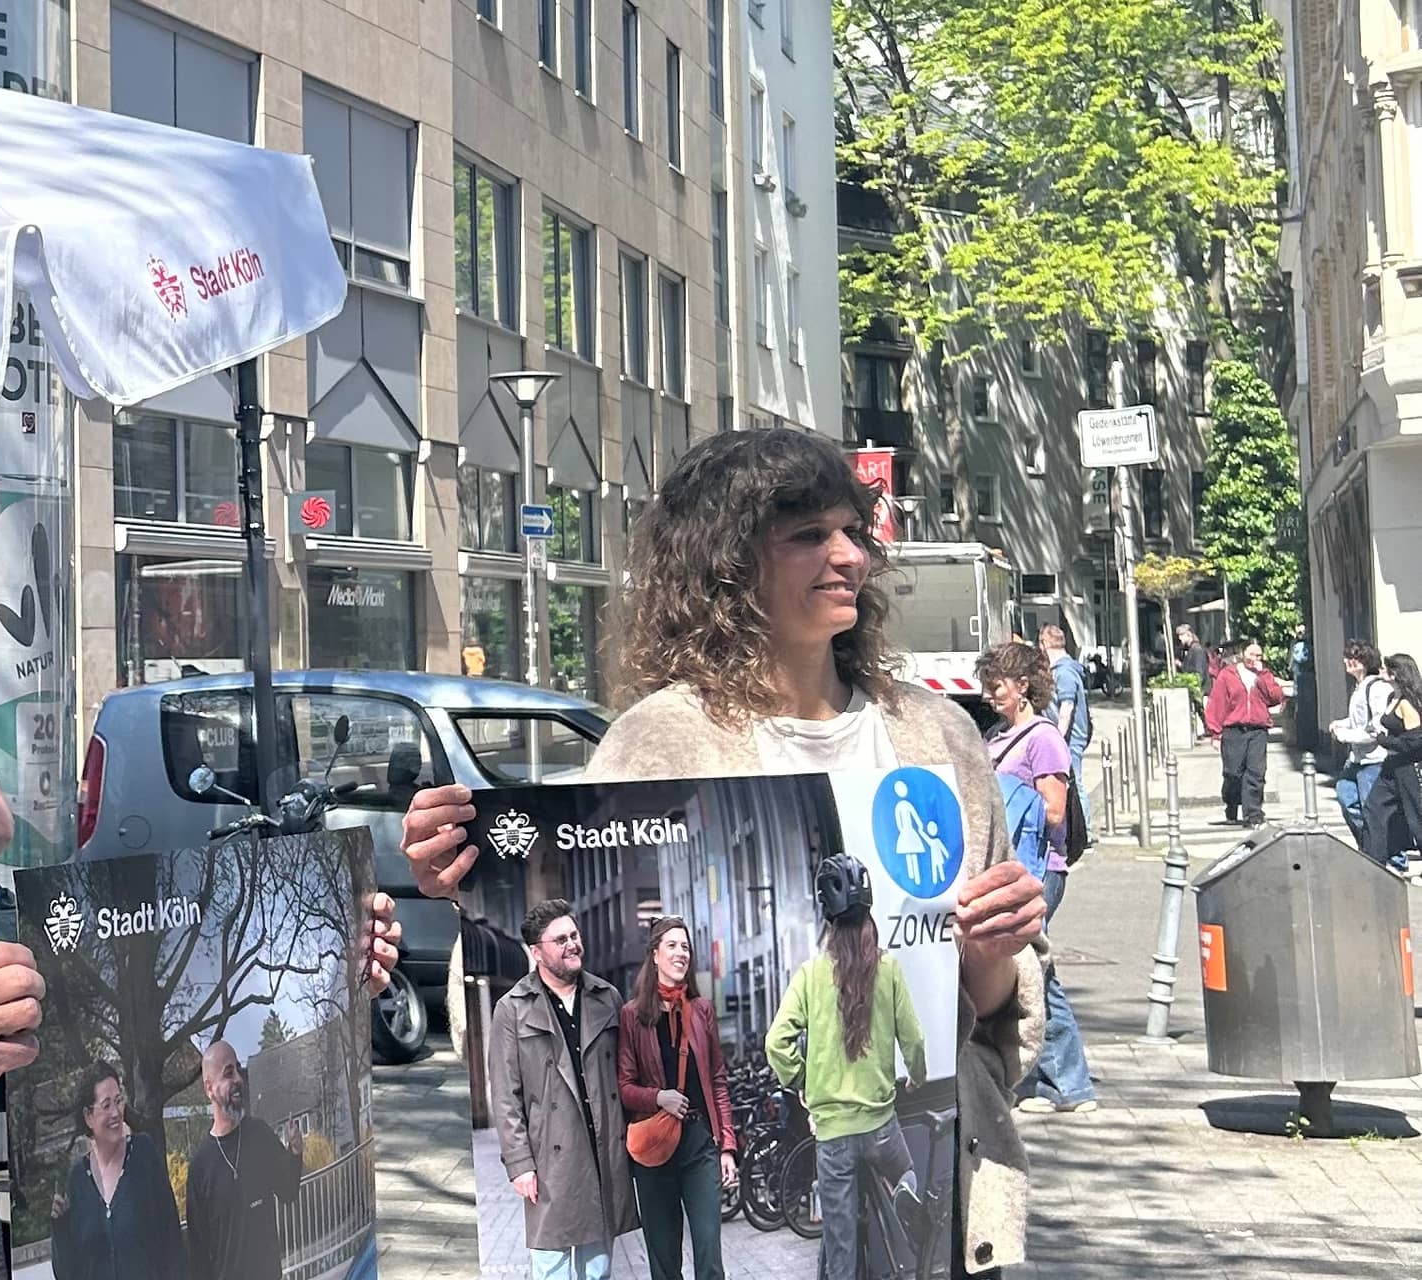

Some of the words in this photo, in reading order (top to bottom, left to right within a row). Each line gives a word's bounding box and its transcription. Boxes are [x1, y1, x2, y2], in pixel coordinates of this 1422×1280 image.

[189, 256, 235, 300] Stadt
[229, 247, 265, 286] Köln
[556, 820, 629, 850] Stadt
[631, 817, 689, 846] Köln
[97, 902, 155, 940] Stadt
[159, 895, 202, 930] Köln
[887, 911, 957, 949] ZONE
